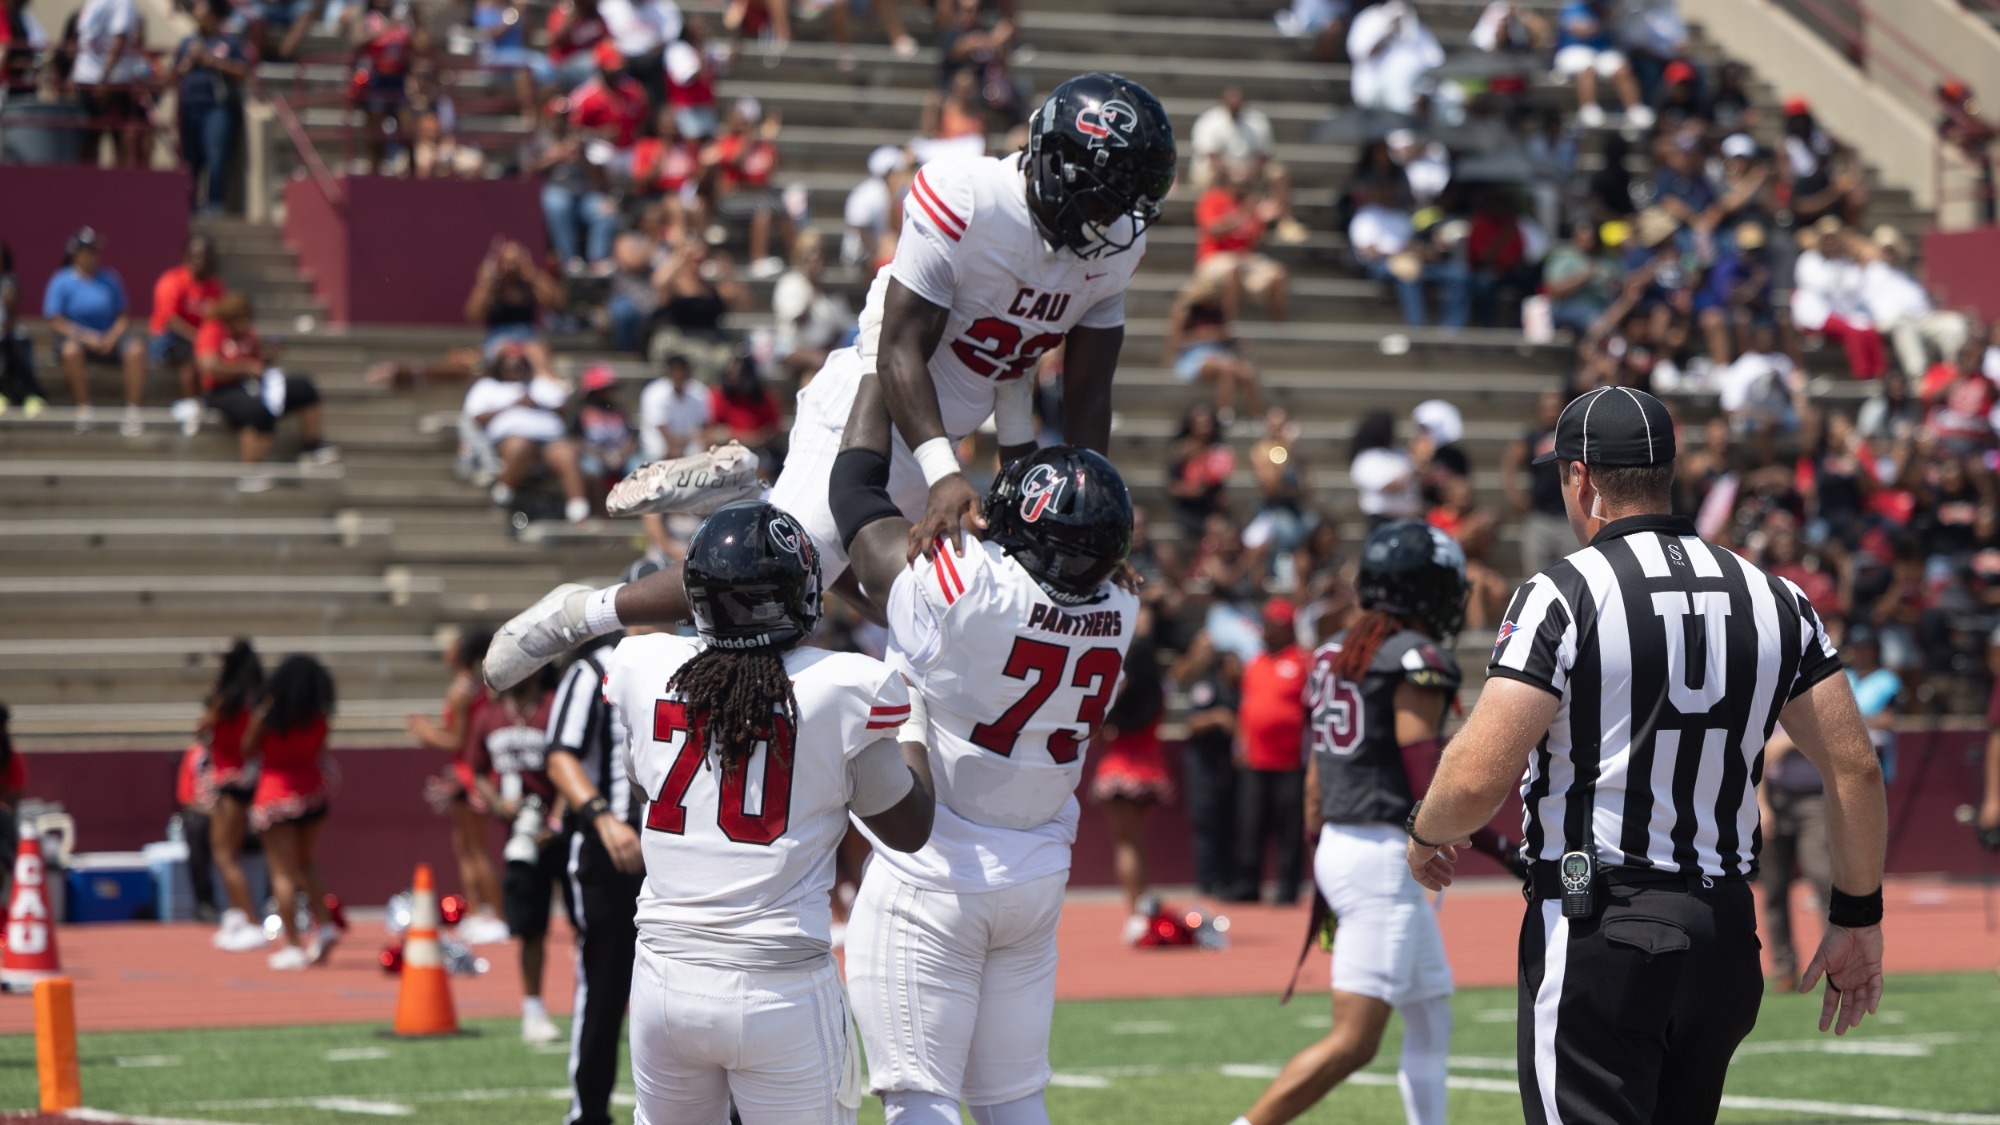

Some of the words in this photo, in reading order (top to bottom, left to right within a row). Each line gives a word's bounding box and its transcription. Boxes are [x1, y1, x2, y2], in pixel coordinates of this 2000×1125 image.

[1008, 287, 1071, 322] CAU
[705, 633, 771, 649] Riddell
[1027, 602, 1122, 637] PANTHERS
[1650, 591, 1732, 714] U
[969, 635, 1123, 765] 73
[645, 699, 797, 847] 70
[7, 853, 48, 955] CAU
